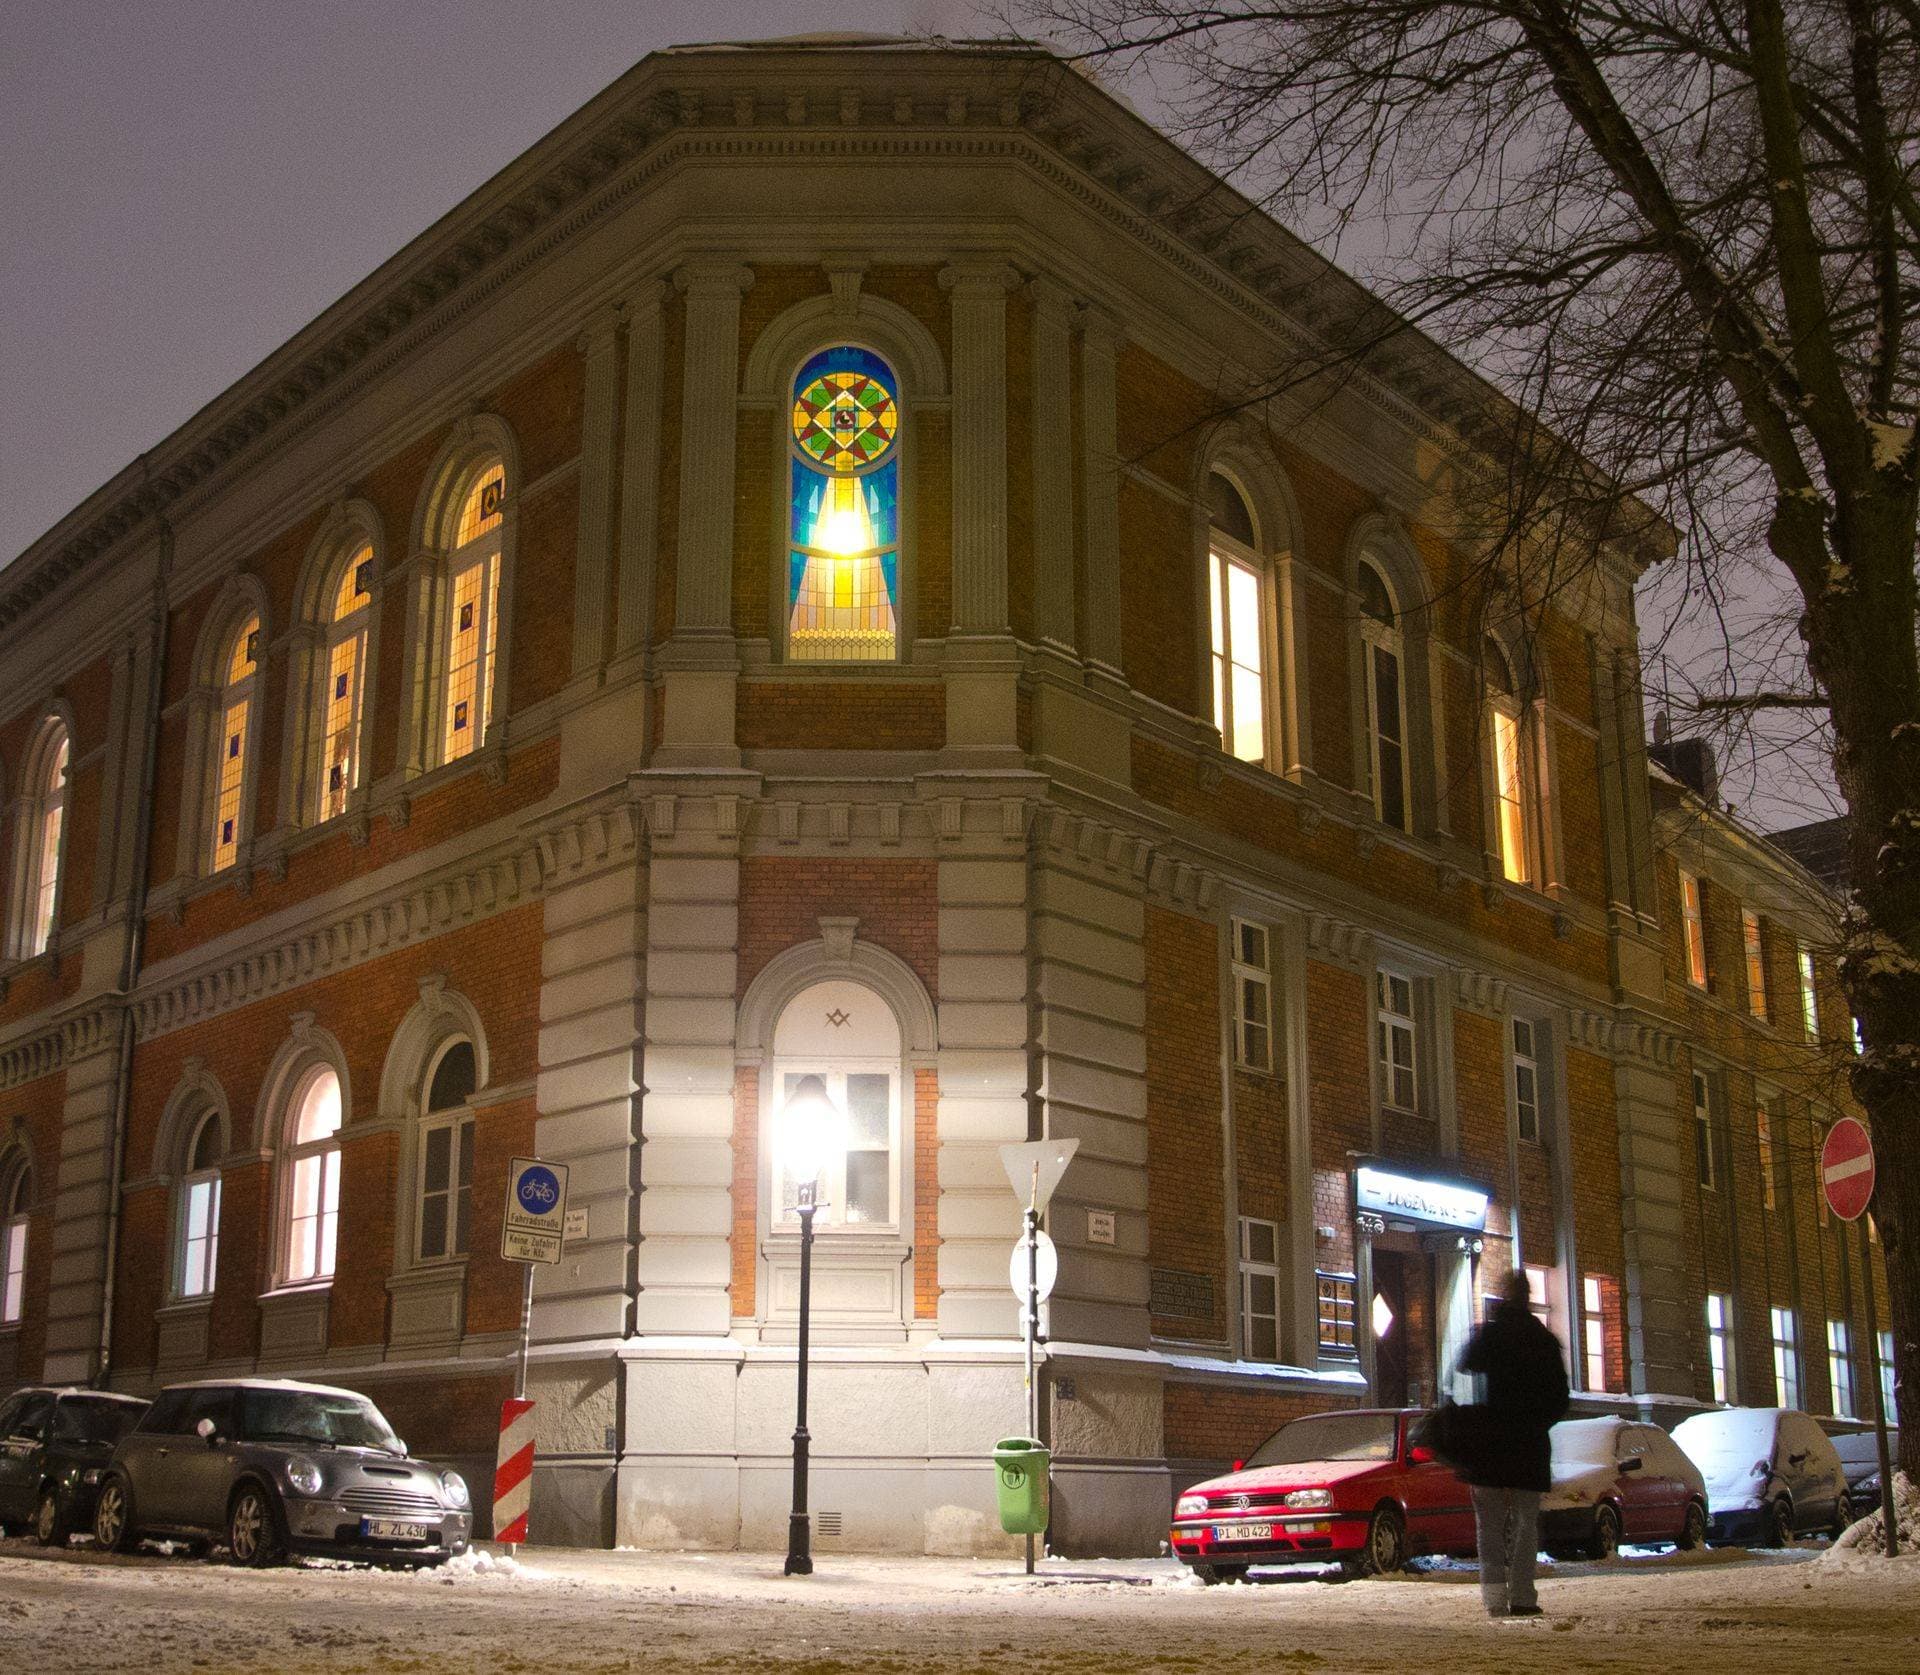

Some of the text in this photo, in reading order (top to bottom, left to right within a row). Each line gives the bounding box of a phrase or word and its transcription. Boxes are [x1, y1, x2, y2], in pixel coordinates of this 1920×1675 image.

[1387, 1190, 1458, 1218] LOGEN
[511, 1212, 559, 1229] Fahrradstraße
[509, 1234, 557, 1250] Keine Zufahrt
[369, 1522, 383, 1535] HL
[390, 1523, 405, 1536] ZL
[1218, 1526, 1271, 1539] PI MD 422
